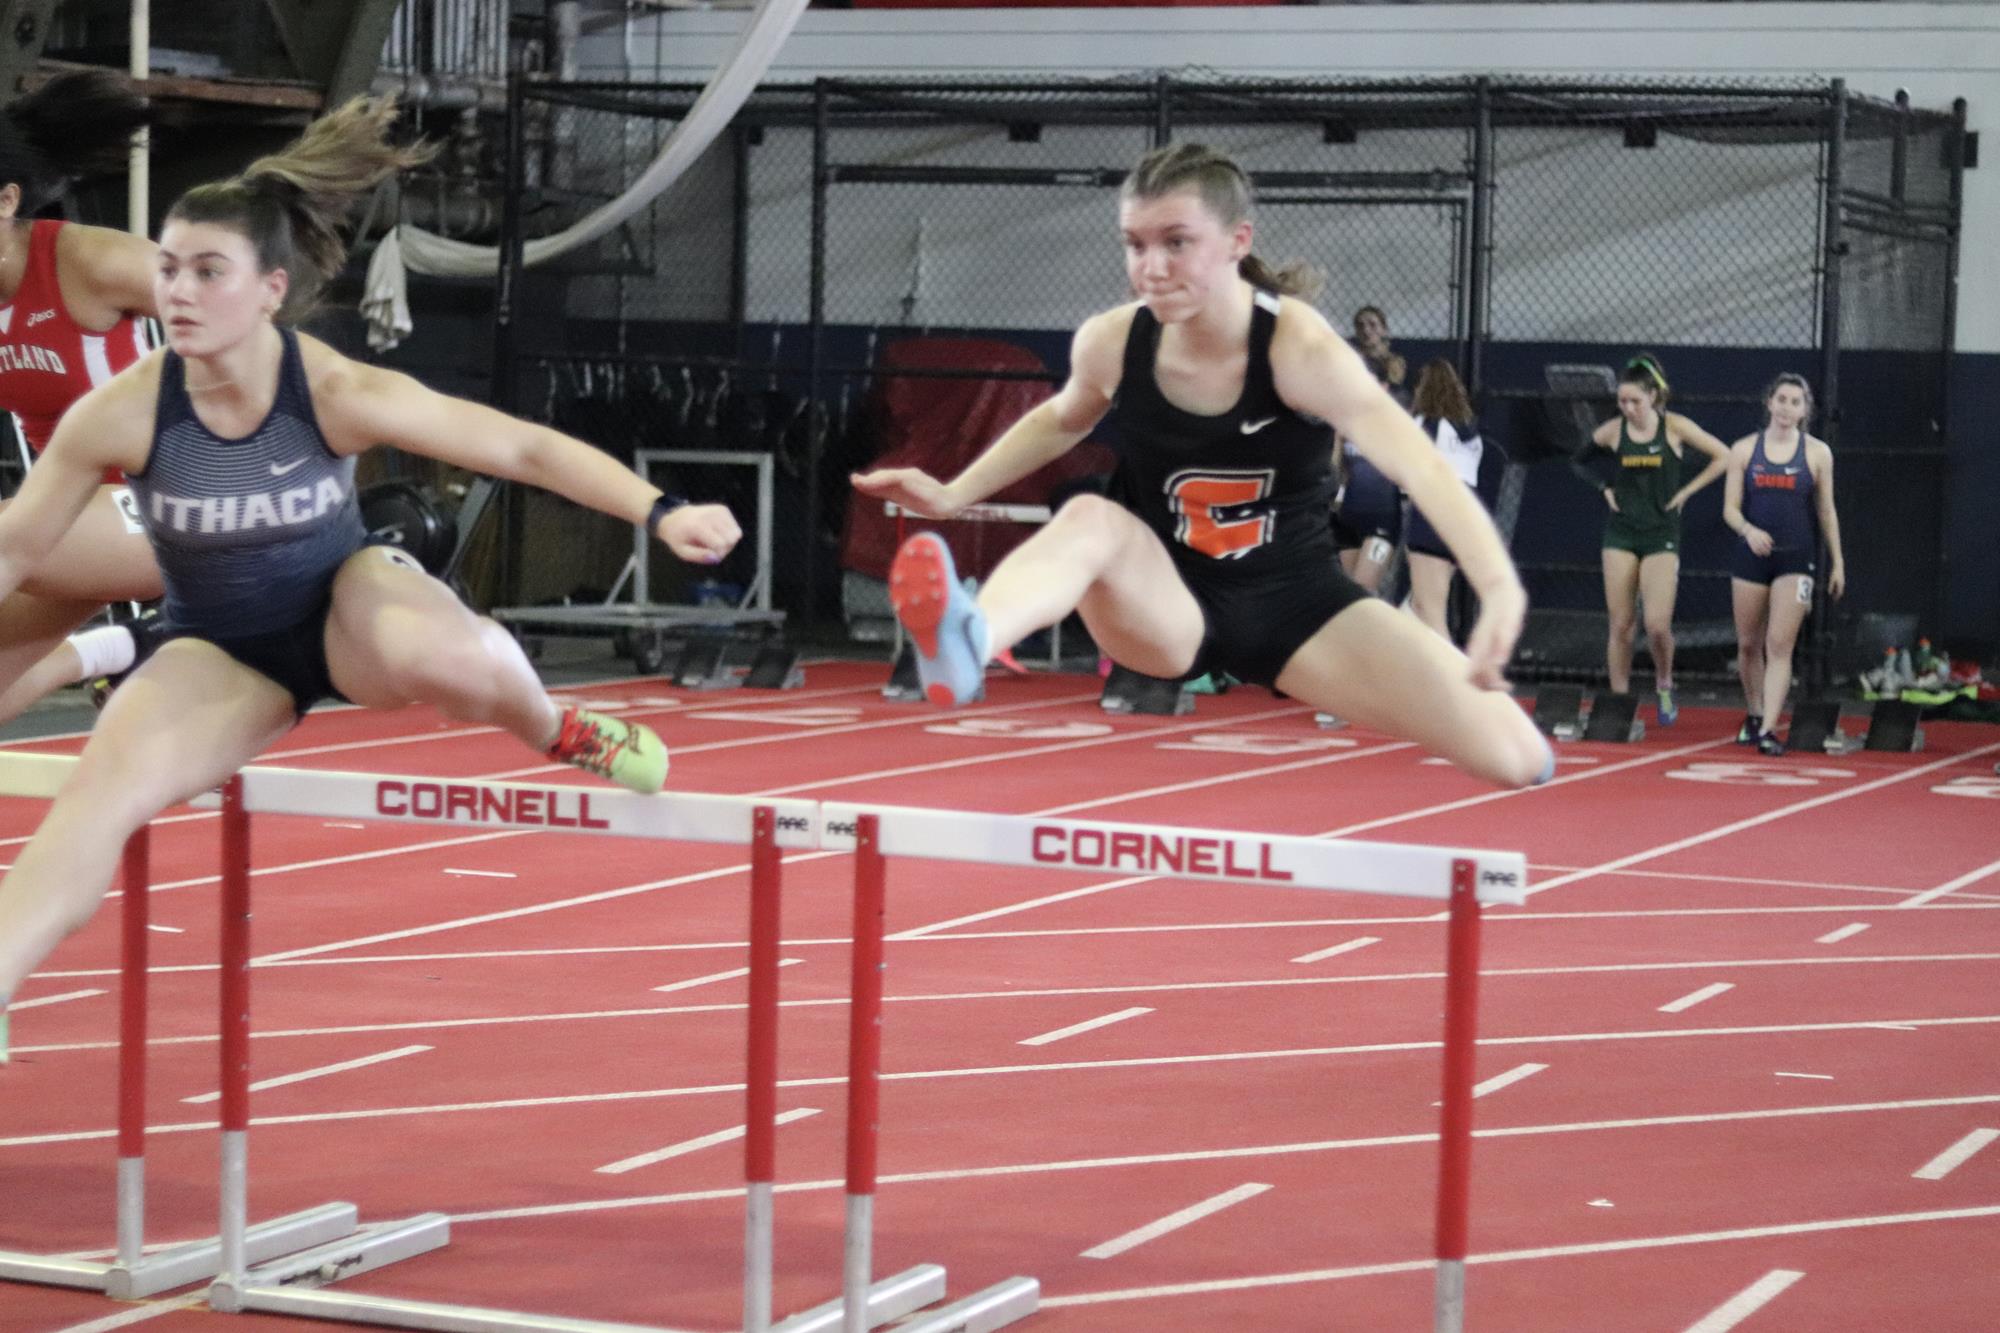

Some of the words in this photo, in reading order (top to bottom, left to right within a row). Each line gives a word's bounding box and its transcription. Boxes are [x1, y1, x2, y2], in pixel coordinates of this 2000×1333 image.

[0, 344, 67, 375] TLAND
[152, 476, 344, 533] ITHACA
[376, 780, 611, 830] CORNELL
[1032, 826, 1294, 881] CORNELL
